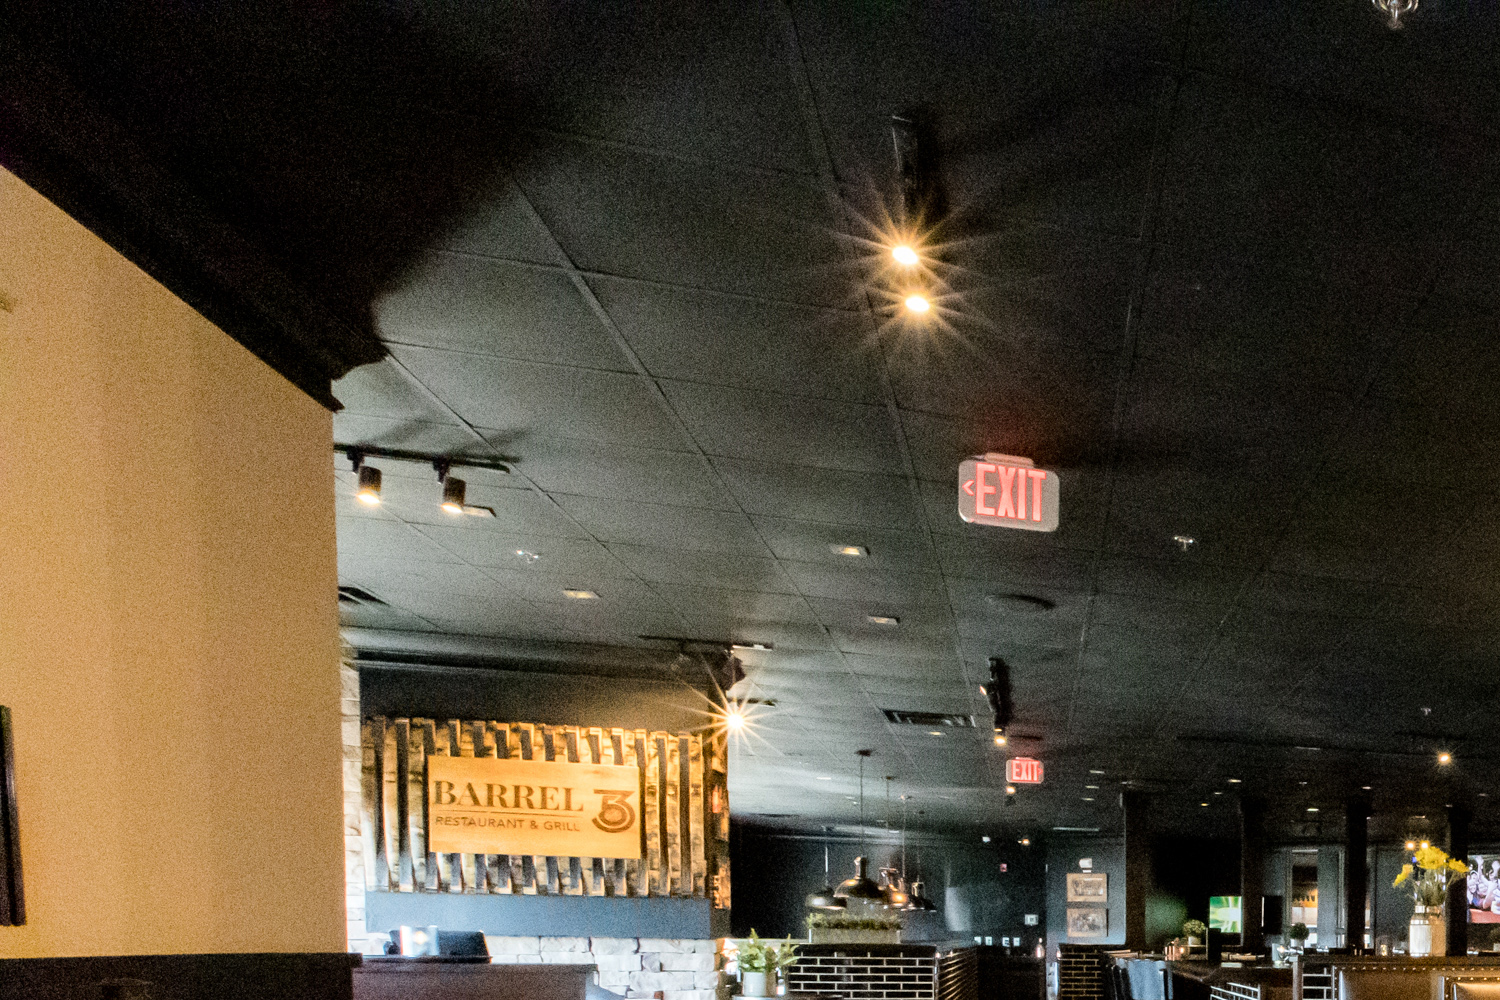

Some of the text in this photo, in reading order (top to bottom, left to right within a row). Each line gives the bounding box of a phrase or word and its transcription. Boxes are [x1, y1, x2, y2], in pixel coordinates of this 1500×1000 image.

[976, 462, 1047, 522] EXIT
[1012, 760, 1040, 781] EXIT
[433, 780, 583, 811] BARREL
[435, 816, 580, 831] RESTAURANT & GRILL
